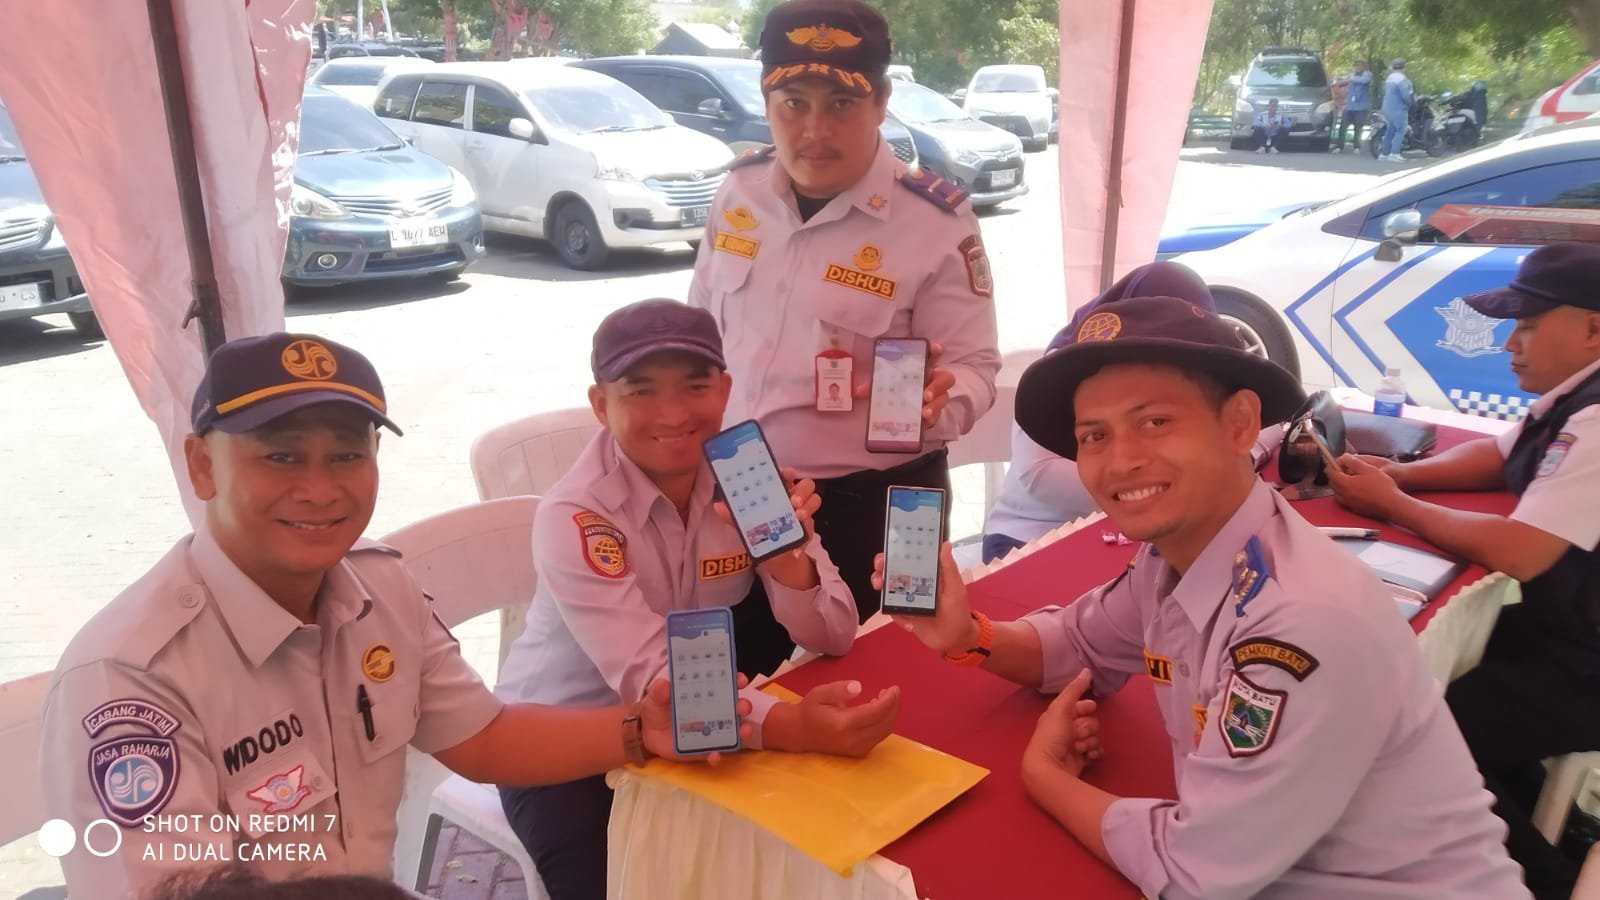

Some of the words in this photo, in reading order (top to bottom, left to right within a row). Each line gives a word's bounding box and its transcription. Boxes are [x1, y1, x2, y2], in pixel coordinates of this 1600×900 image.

[828, 266, 892, 295] DISHUB
[705, 555, 749, 576] DISH
[1238, 645, 1277, 659] PEMKOT
[1278, 649, 1306, 669] BATU
[1251, 691, 1276, 706] BATU
[90, 705, 137, 728] CABANG
[139, 708, 172, 732] JATIM
[96, 747, 119, 766] JASA
[121, 743, 170, 760] RAHARJA
